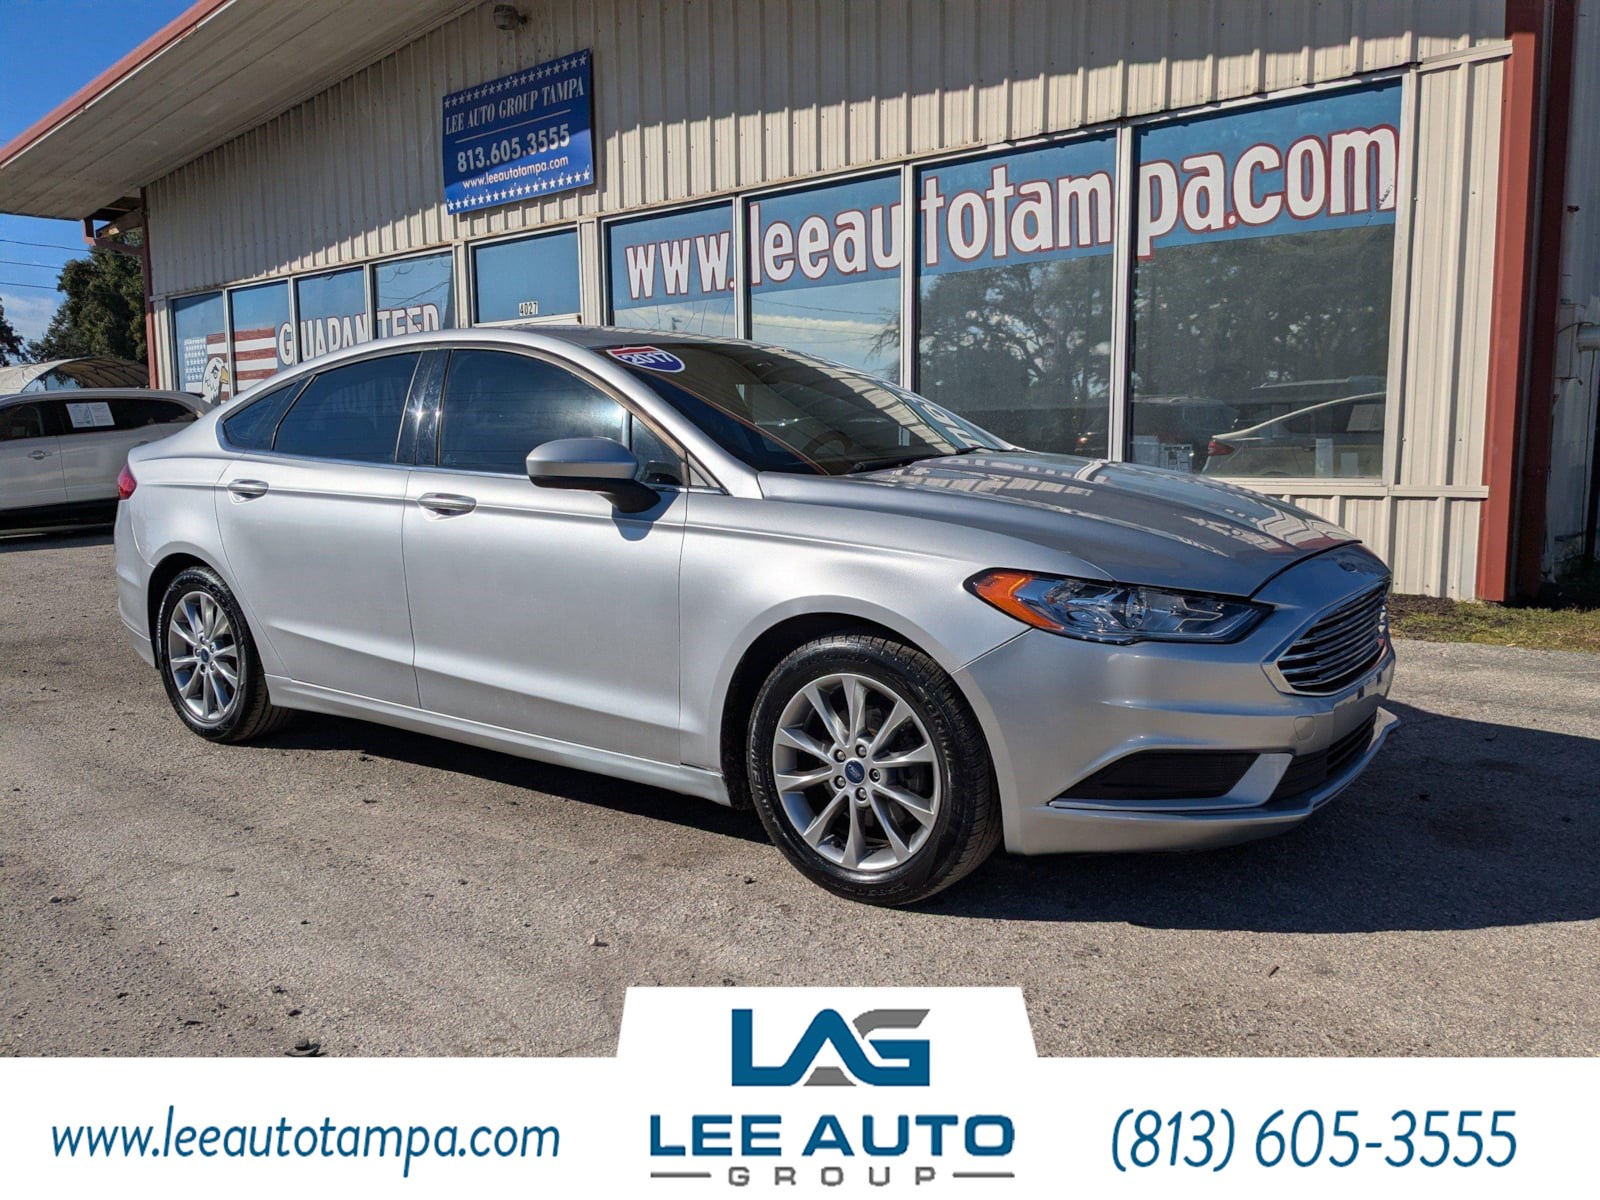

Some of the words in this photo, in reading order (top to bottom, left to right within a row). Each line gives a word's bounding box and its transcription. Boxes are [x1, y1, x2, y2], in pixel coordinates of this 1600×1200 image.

[445, 112, 464, 136] LEE
[467, 104, 495, 128] AUTO
[498, 90, 538, 119] GROUP
[541, 76, 584, 106] TAMPA
[457, 123, 570, 173] 813.605.3555
[462, 156, 568, 188] www.leeautotampa.com
[519, 302, 537, 315] 4027
[620, 352, 674, 364] 2017
